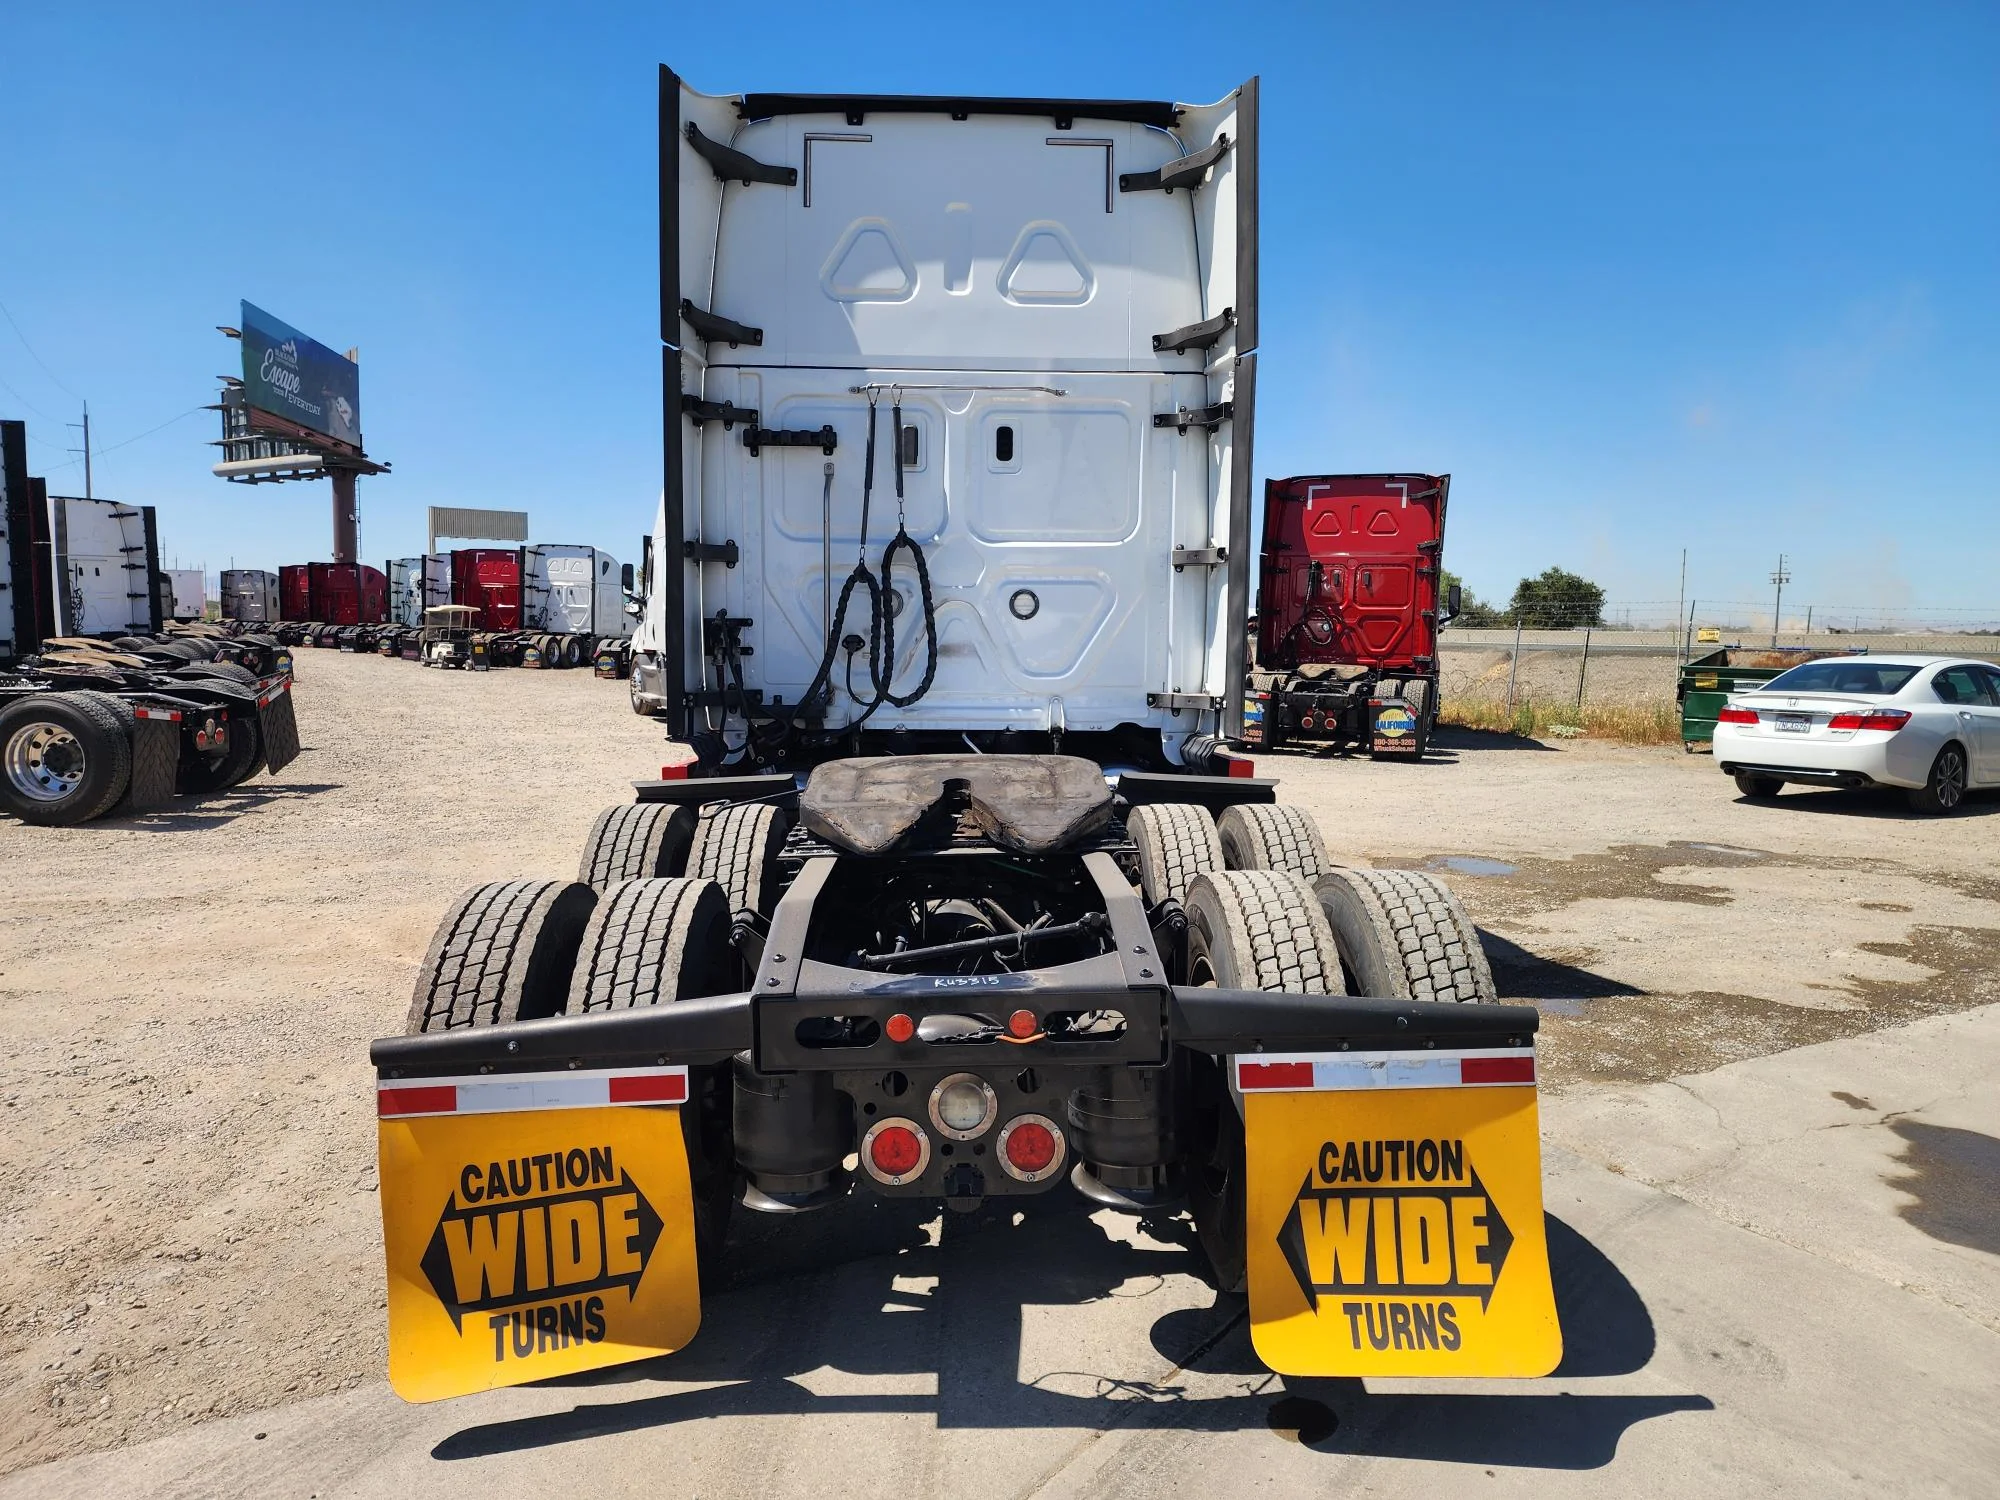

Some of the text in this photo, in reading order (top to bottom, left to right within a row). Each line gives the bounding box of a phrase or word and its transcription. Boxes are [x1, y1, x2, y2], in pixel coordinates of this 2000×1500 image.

[261, 348, 300, 398] Escape
[288, 393, 321, 415] EVERYDAY
[461, 1146, 614, 1203] CAUTION
[1319, 1138, 1463, 1184] CAUTION
[442, 1192, 642, 1304] WIDE
[1298, 1196, 1494, 1286] WIDE
[489, 1295, 606, 1363] TURNS
[1343, 1302, 1462, 1351] TURNS
